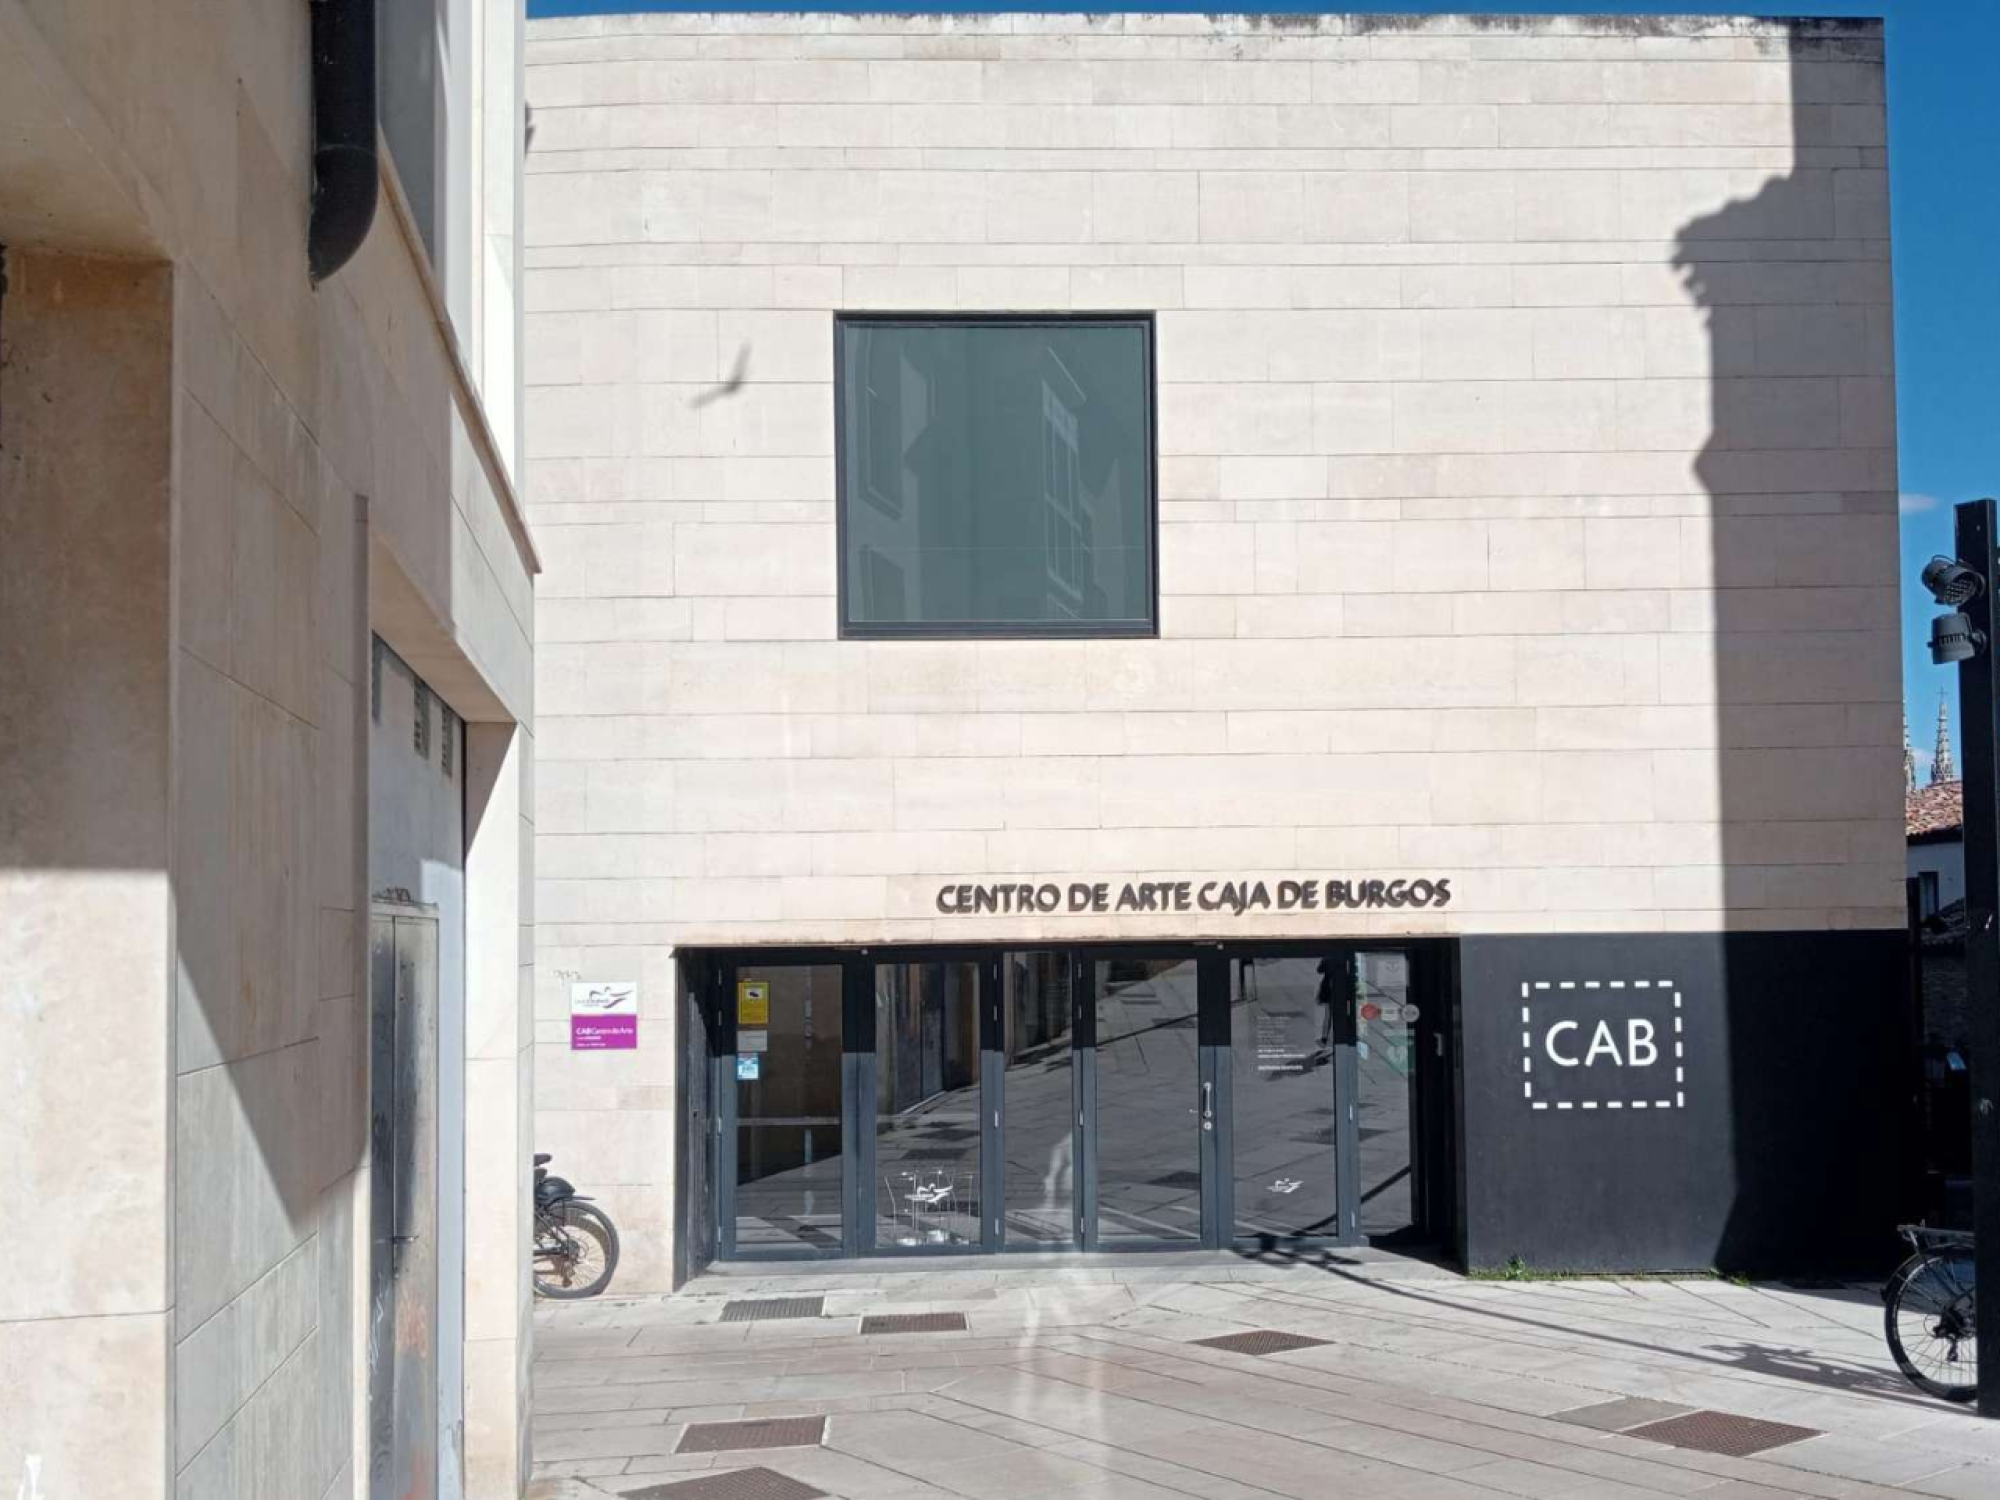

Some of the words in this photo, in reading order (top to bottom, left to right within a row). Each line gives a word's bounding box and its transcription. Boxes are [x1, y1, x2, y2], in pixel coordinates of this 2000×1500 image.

[936, 883, 1061, 914] CENTRO
[1067, 882, 1110, 912] DE
[1115, 881, 1192, 911] ARTE
[1197, 880, 1271, 917] CAJA
[1277, 880, 1319, 910] DE
[1325, 878, 1451, 909] BURGOS
[1545, 1018, 1658, 1067] CAB
